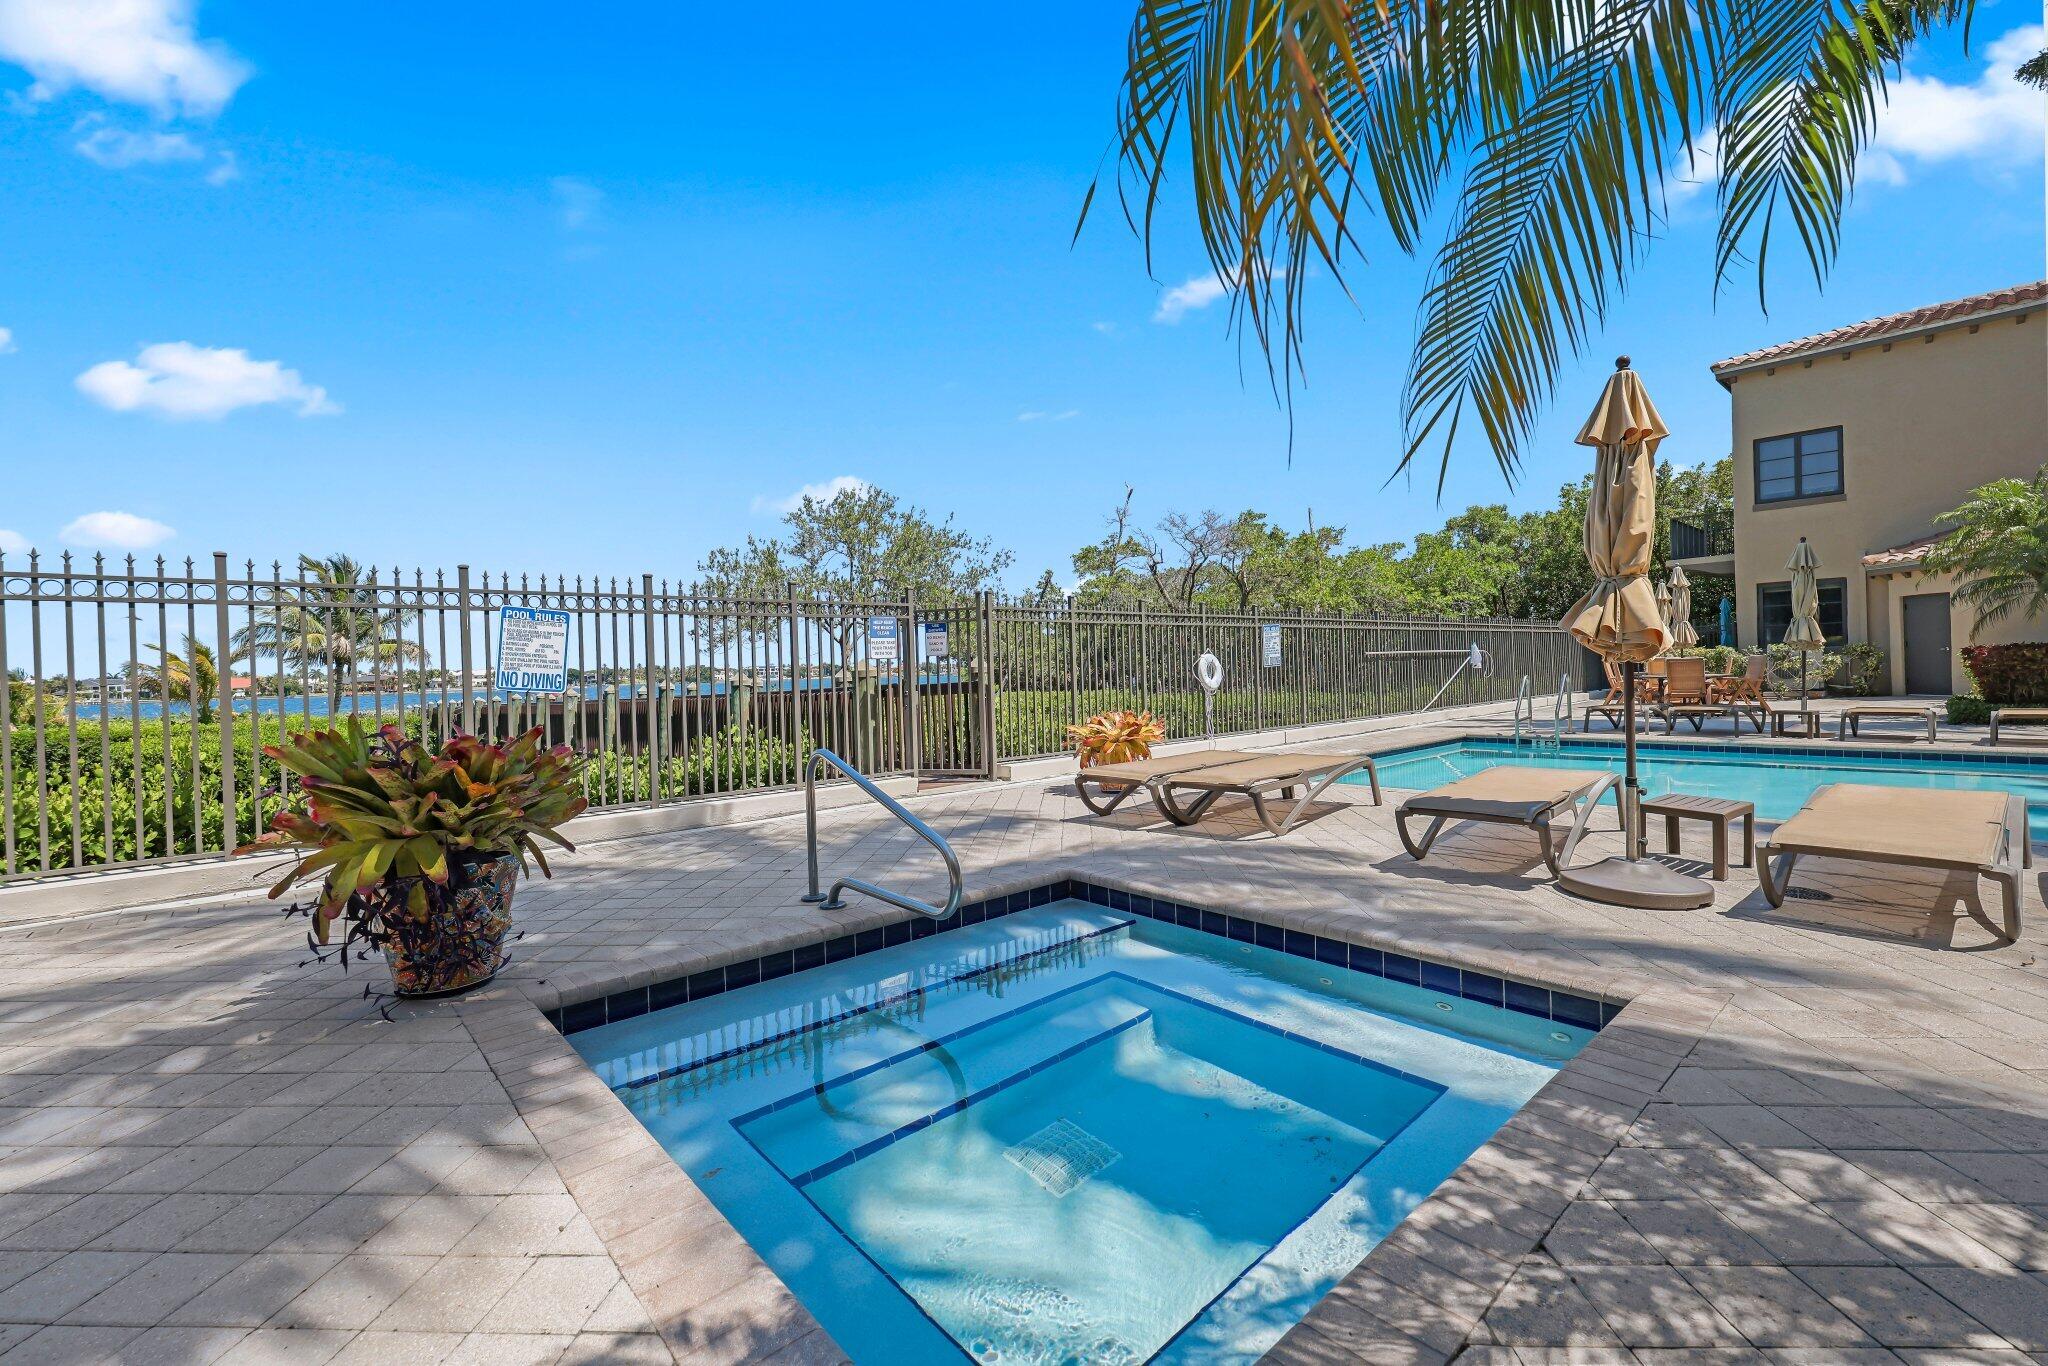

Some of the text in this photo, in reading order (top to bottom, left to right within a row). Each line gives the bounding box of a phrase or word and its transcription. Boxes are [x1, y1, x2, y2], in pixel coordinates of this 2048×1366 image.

[505, 610, 566, 623] POOL RULES
[500, 671, 562, 689] NO DIVING
